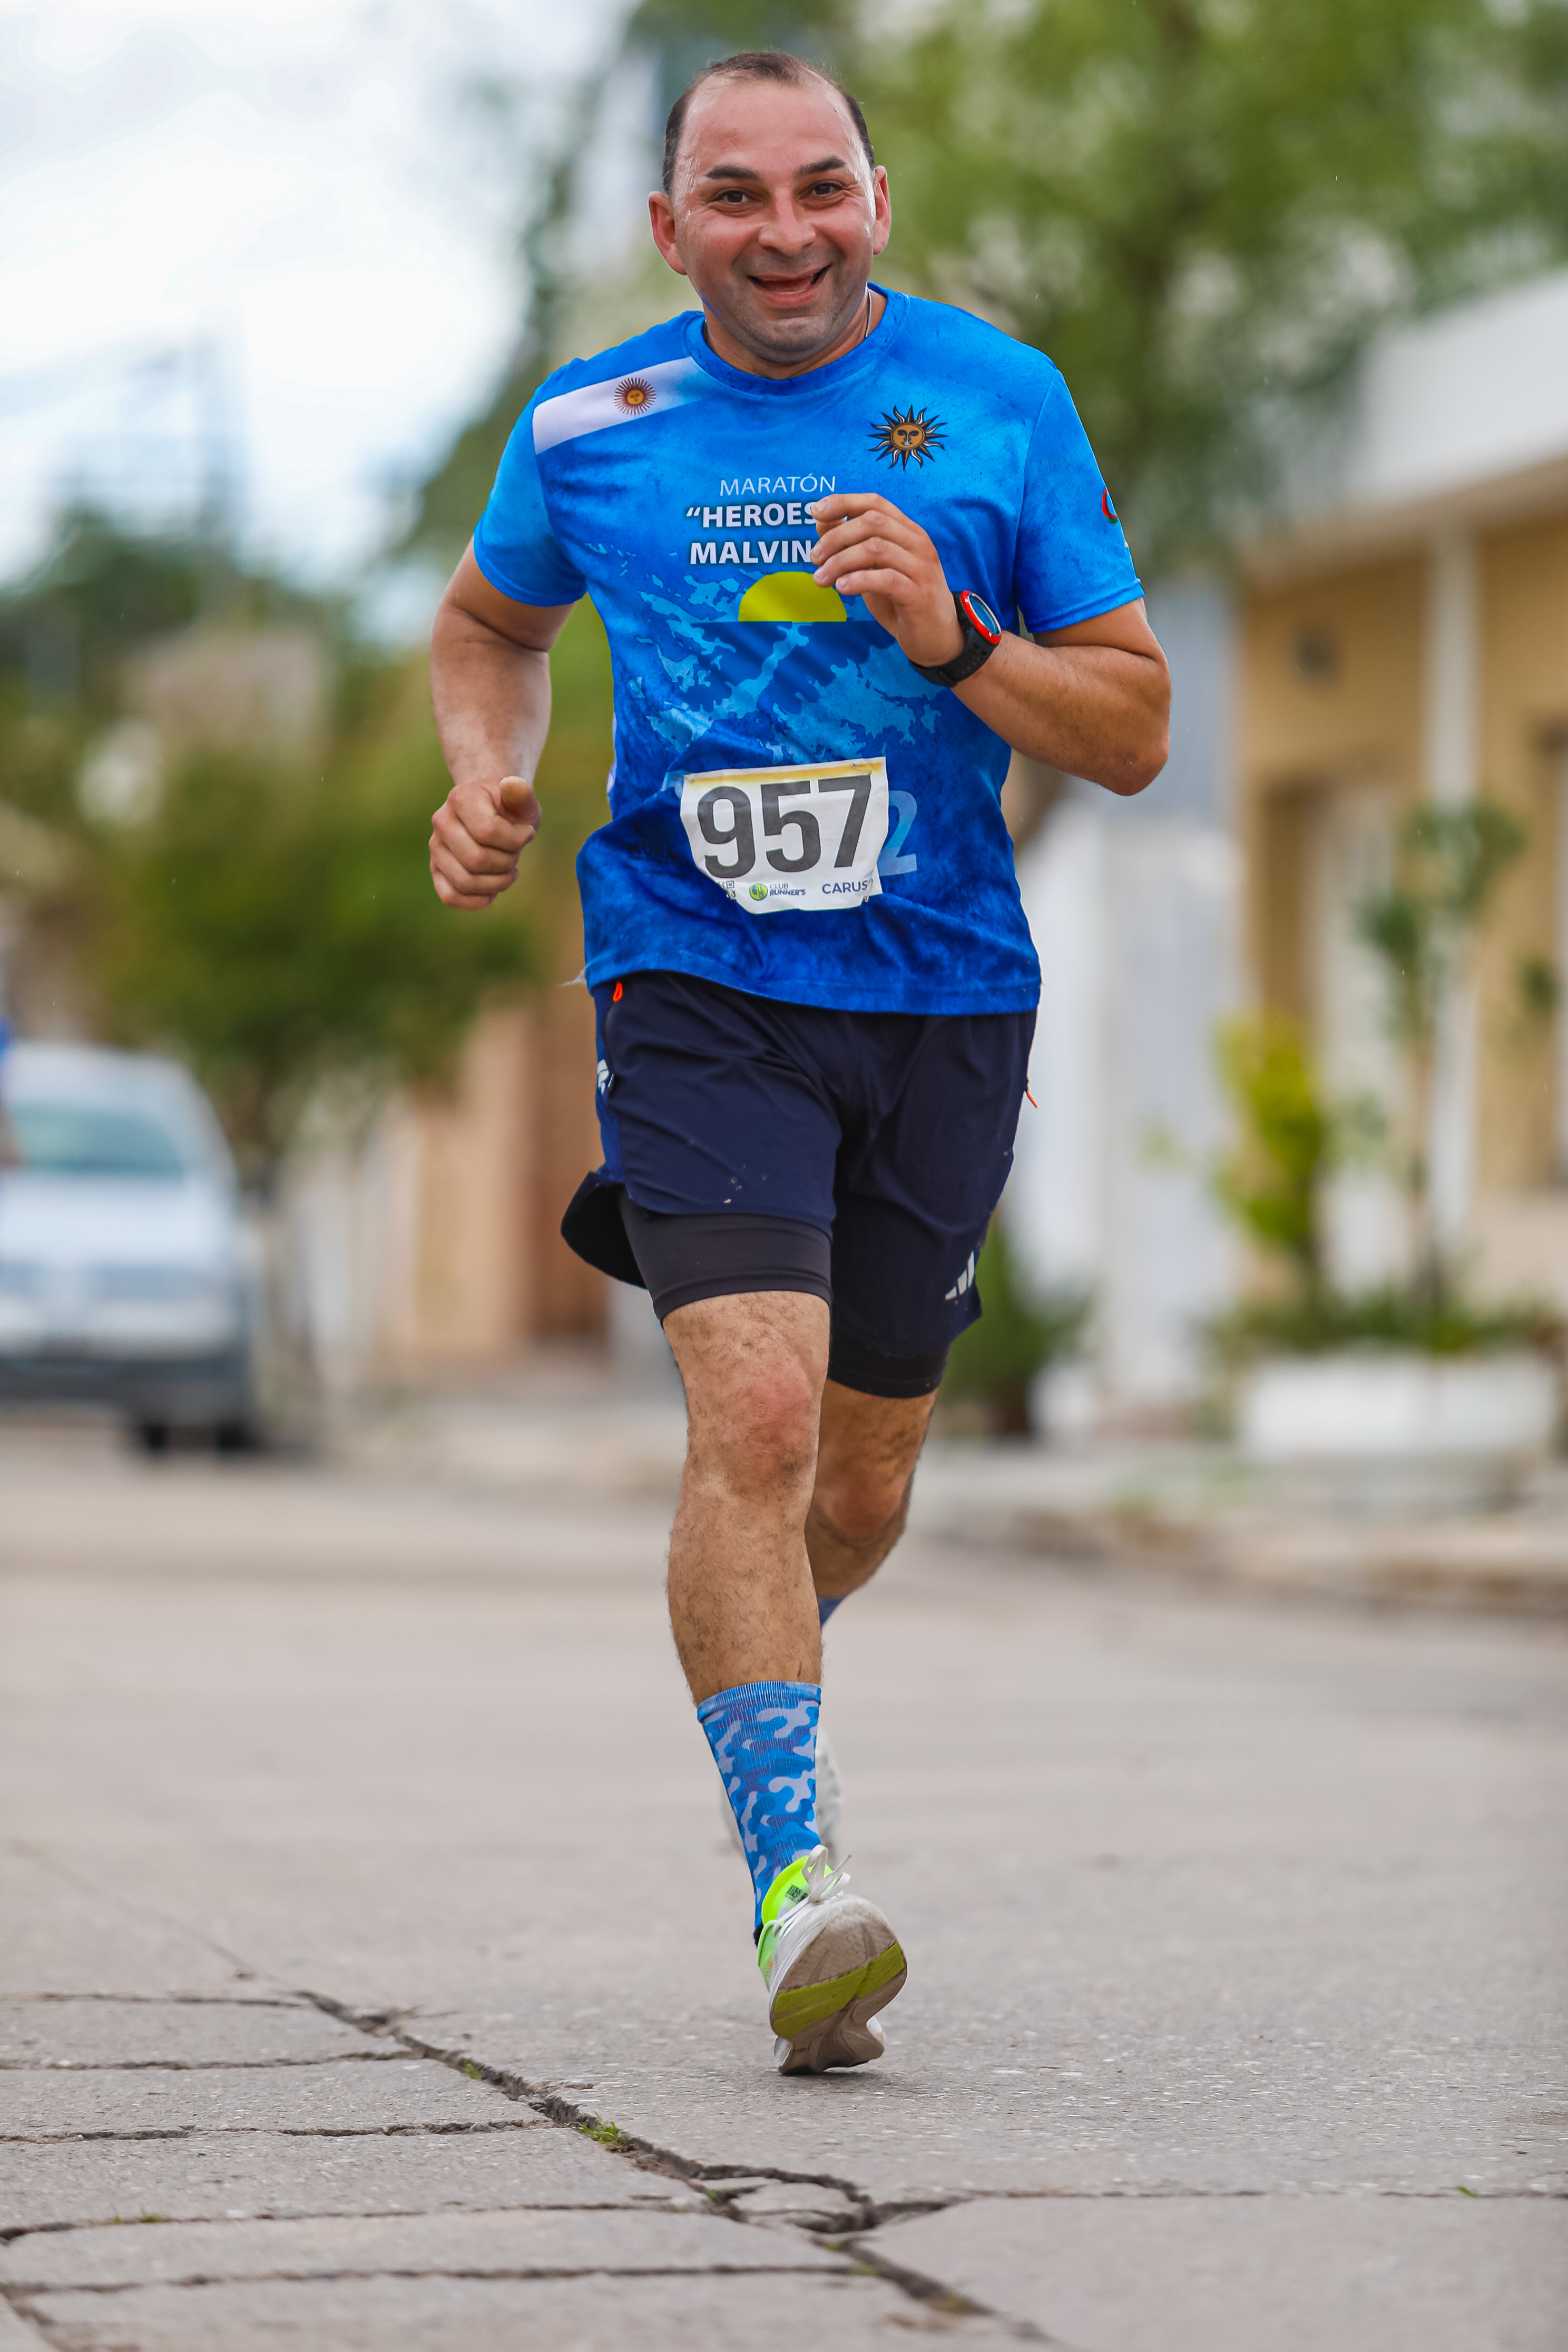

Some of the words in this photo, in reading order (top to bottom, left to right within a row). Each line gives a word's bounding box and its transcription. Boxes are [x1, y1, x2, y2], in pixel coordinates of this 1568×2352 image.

[720, 473, 836, 496] MARATÓN
[690, 539, 811, 564] MALVIN
[697, 773, 872, 878] 957
[822, 880, 868, 894] CARUS
